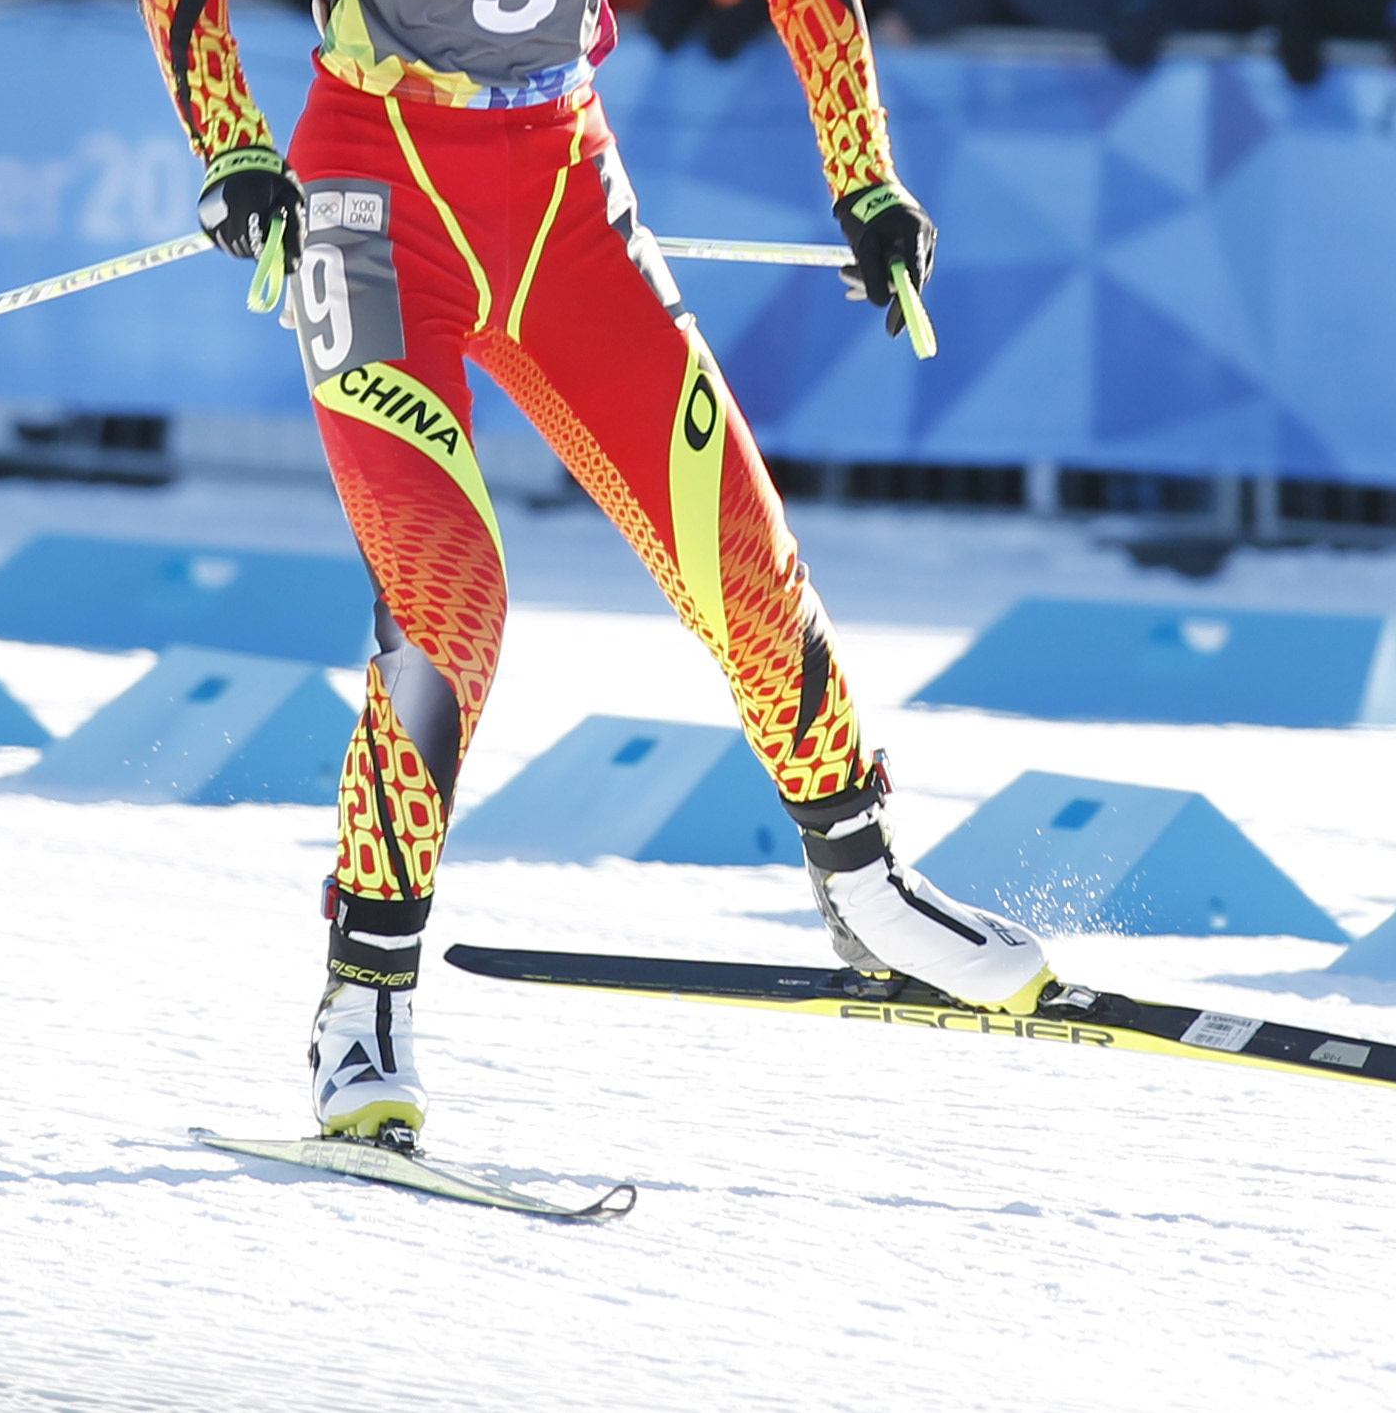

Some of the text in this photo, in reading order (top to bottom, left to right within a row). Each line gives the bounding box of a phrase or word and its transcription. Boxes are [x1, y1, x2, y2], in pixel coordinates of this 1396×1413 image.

[349, 211, 375, 225] DNA
[352, 199, 377, 213] YOG
[300, 242, 353, 372] 9
[340, 367, 459, 456] CHINA
[330, 958, 416, 986] FISCHER
[840, 1004, 1115, 1048] FISCHER
